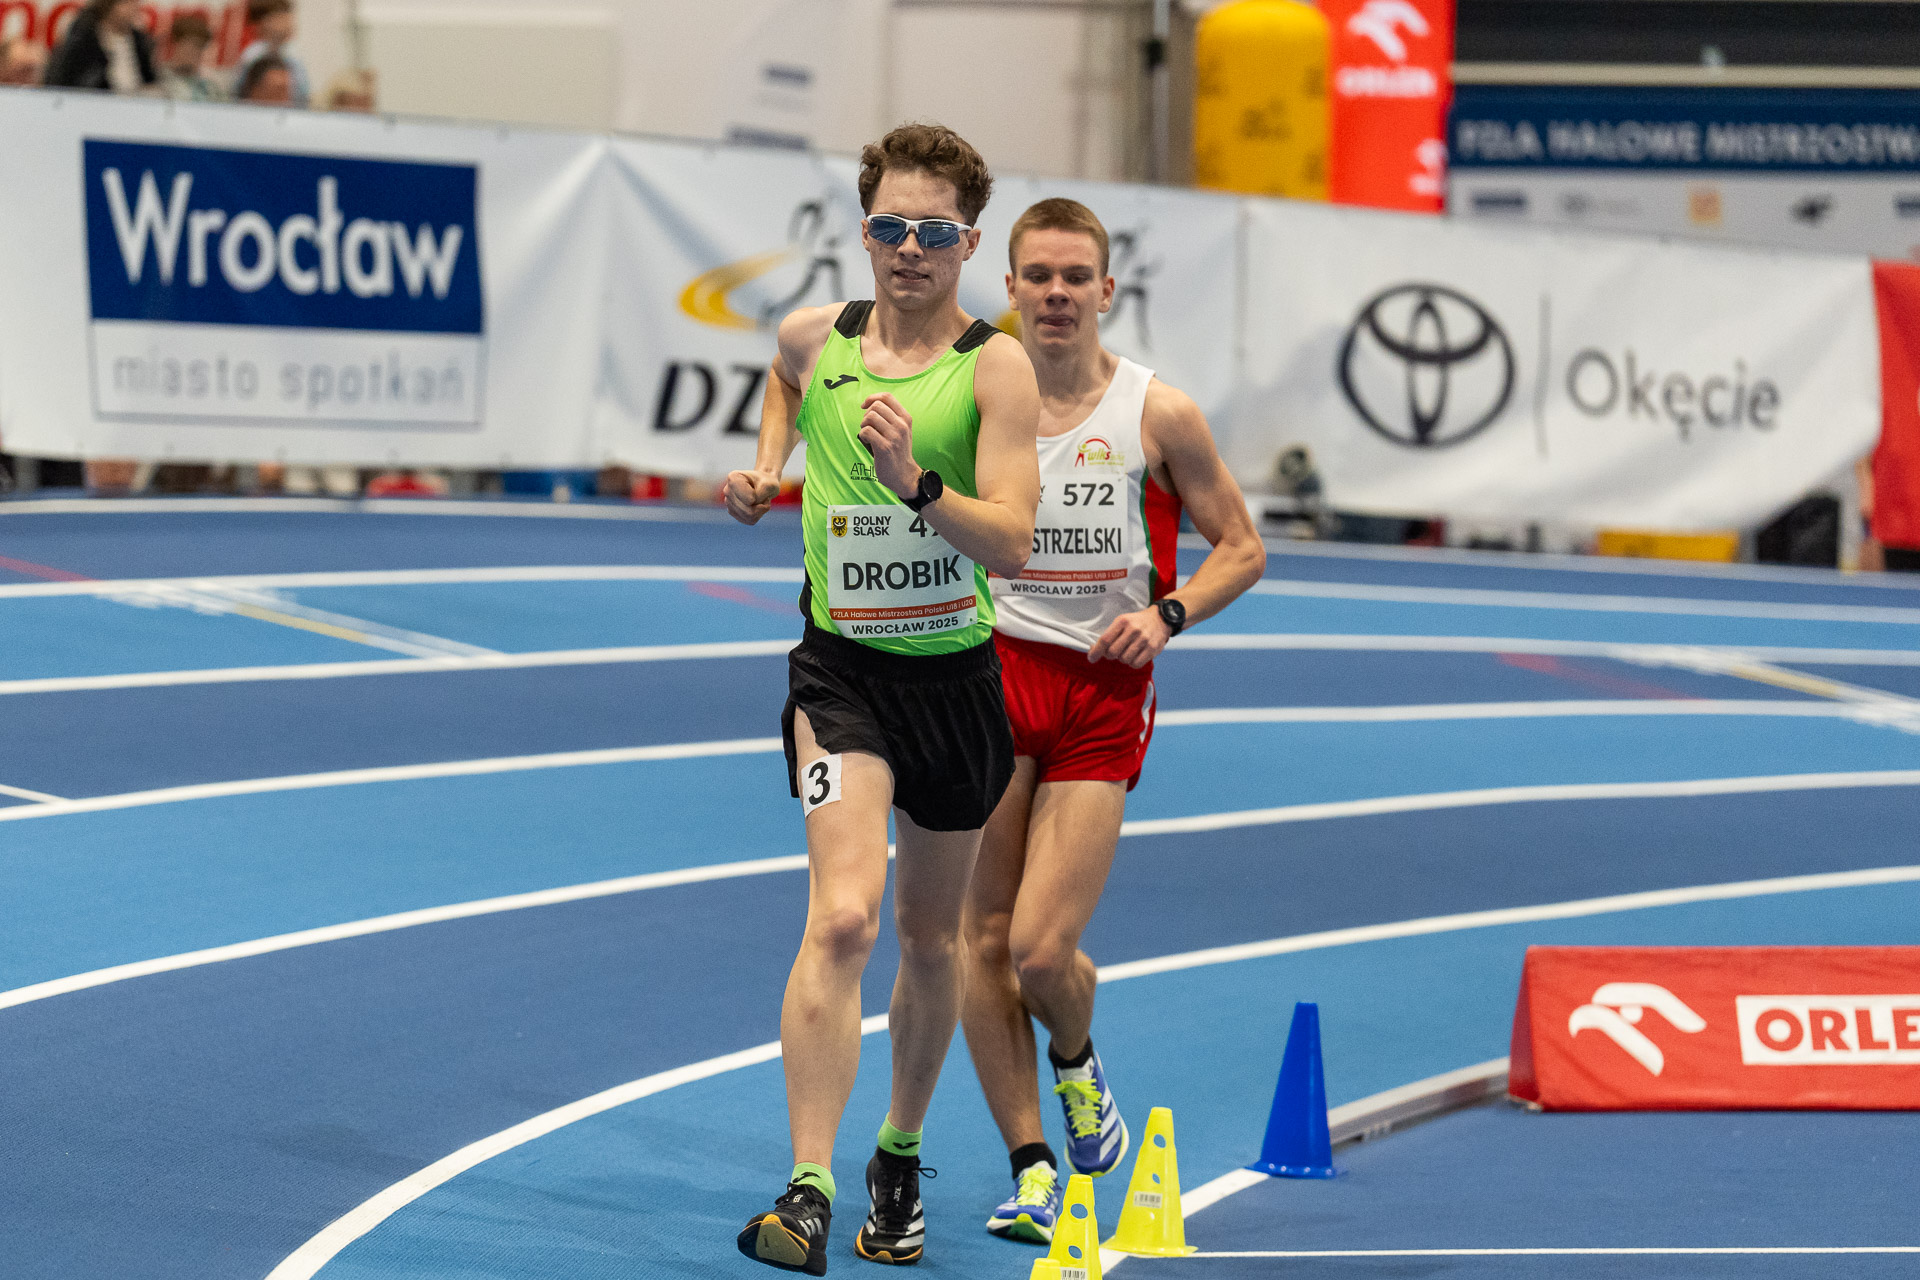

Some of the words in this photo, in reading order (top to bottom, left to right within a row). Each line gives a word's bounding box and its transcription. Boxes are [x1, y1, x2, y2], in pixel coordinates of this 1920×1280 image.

[1547, 119, 1699, 163] HALOWE
[101, 166, 465, 300] Wrocław
[112, 343, 260, 401] miasto
[279, 348, 465, 412] spotkań
[1565, 346, 1782, 443] Okęcie
[1062, 482, 1115, 507] 572
[853, 516, 892, 526] DOLNY
[853, 525, 890, 538] ŚLĄSK
[842, 554, 962, 591] DROBIK
[1073, 571, 1094, 579] Polski
[1010, 583, 1073, 595] WROCŁAW
[1076, 584, 1107, 595] 2025
[878, 609, 923, 618] Mistrzostwa
[924, 606, 946, 615] Polski
[961, 598, 974, 607] U20
[852, 622, 925, 635] WROCŁAW
[928, 616, 959, 630] 2025
[808, 761, 831, 806] 3
[1755, 1008, 1920, 1052] ORLE
